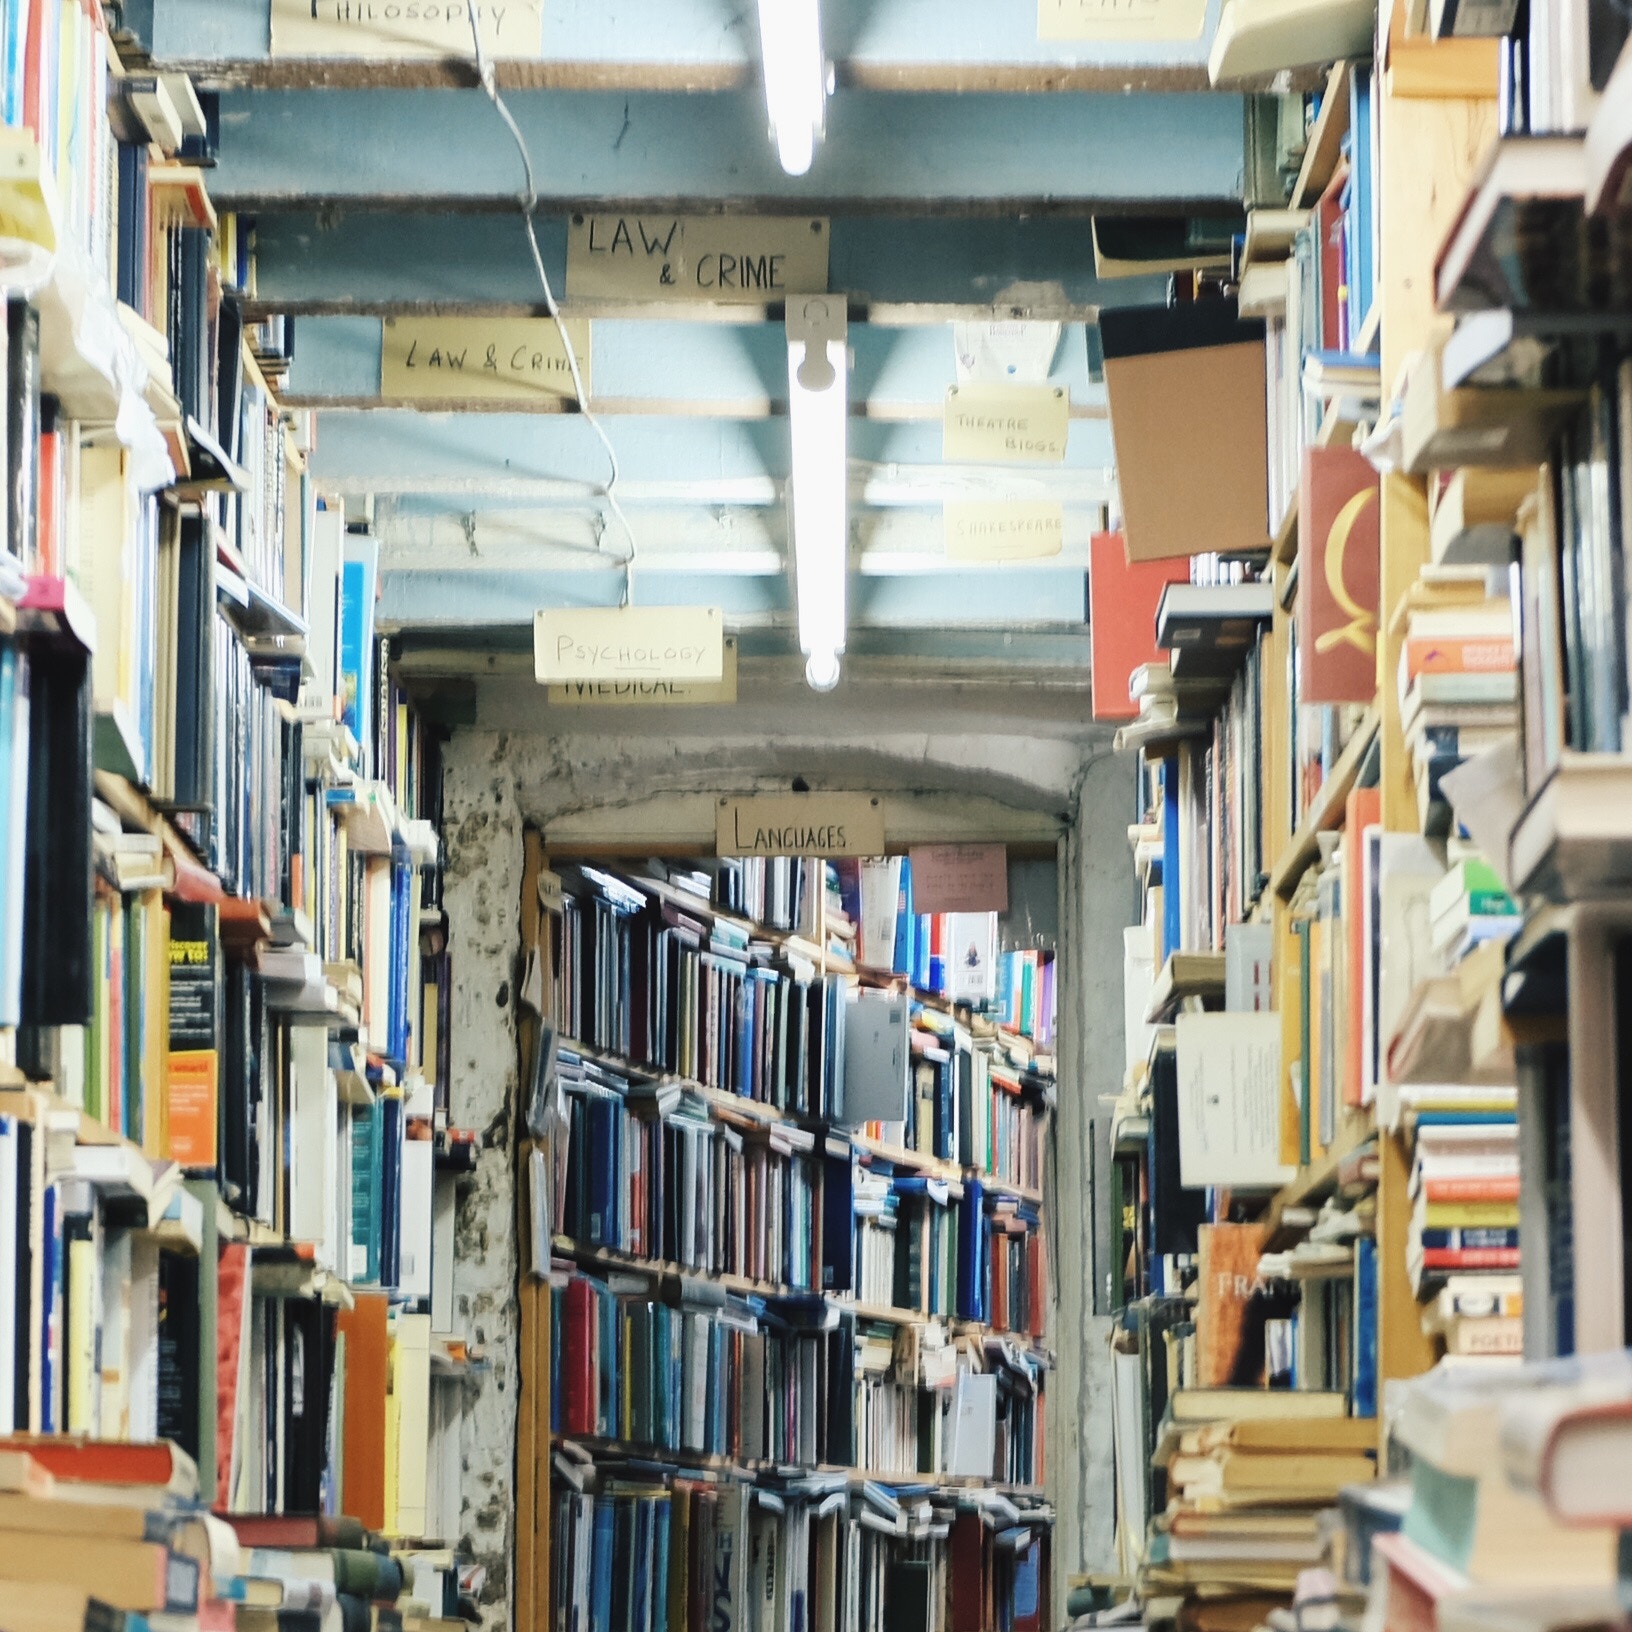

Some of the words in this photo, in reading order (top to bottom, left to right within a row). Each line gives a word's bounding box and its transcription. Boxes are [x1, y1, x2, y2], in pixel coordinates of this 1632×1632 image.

[588, 218, 677, 255] LAW
[659, 263, 676, 286] &
[696, 253, 787, 290] CRIME
[405, 339, 468, 369] LAW
[482, 342, 499, 376] &
[955, 413, 1029, 430] THEATRE
[955, 517, 1063, 537] SHAKESPEARE
[556, 634, 707, 666] PSYCHOLOGY
[1470, 1333, 1521, 1347] POET
